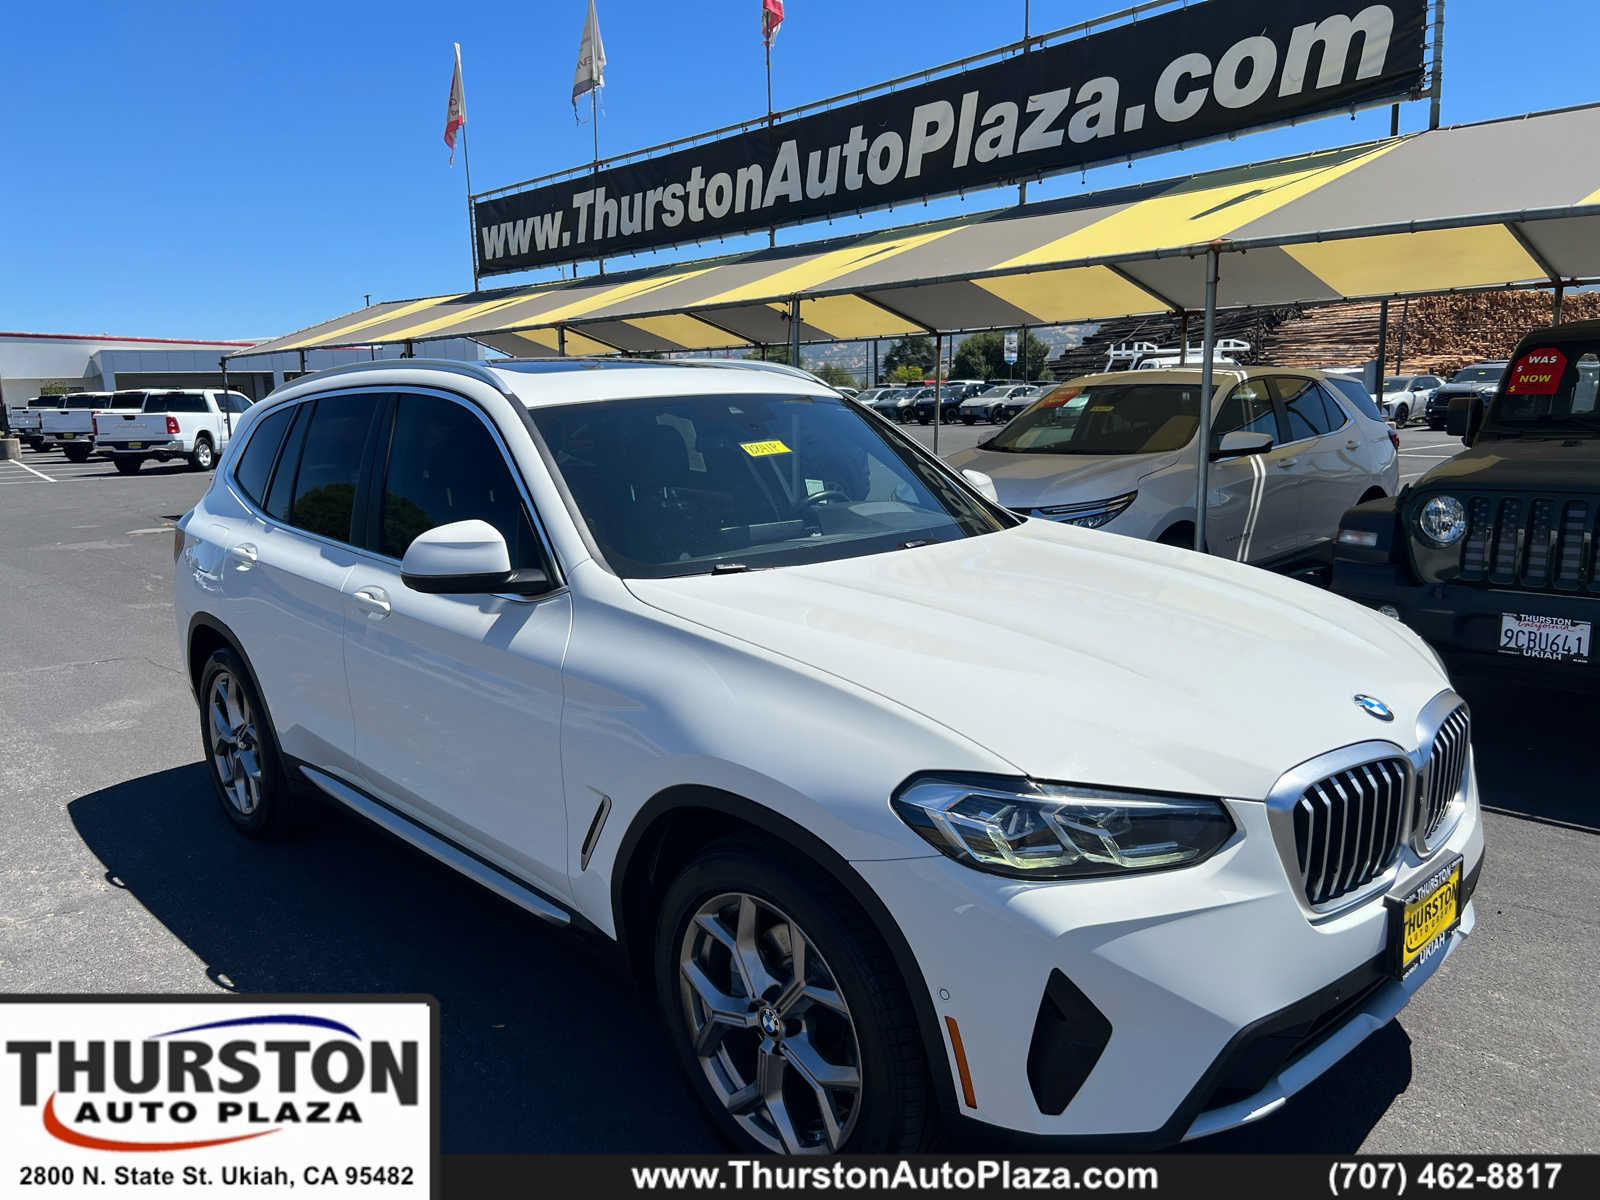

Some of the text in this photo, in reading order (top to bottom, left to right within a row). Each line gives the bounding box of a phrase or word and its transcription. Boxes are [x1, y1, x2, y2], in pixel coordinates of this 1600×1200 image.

[481, 4, 1394, 261] www.ThurstonAutoPlaza.com
[1528, 355, 1558, 364] WAS
[1519, 375, 1552, 383] NOW
[1519, 613, 1572, 627] THURSTON
[1501, 628, 1582, 656] 9CBU641
[1523, 649, 1562, 660] UKIAH
[1417, 865, 1452, 901] THURSTON
[1420, 931, 1446, 964] UKIAH
